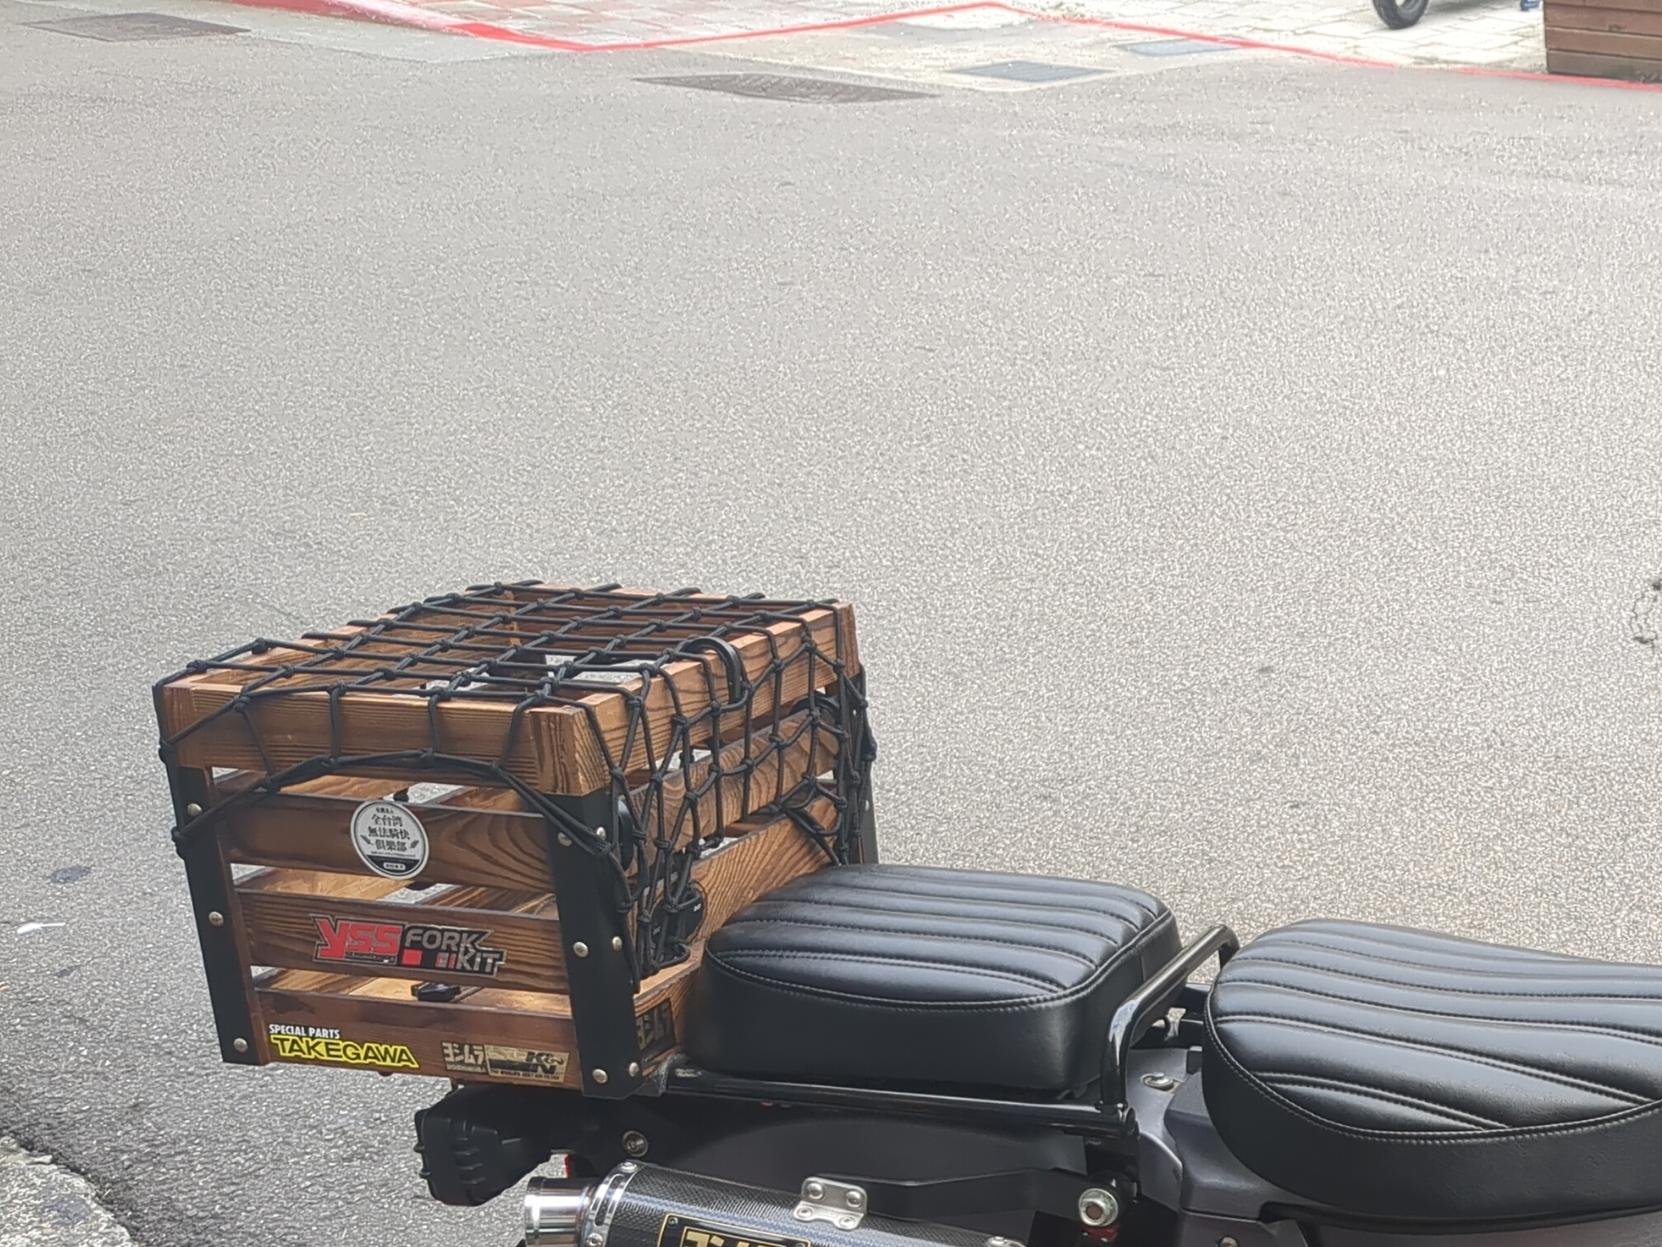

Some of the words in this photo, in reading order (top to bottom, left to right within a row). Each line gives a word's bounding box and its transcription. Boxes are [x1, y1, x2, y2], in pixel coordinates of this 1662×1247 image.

[405, 927, 480, 950] FORK
[456, 943, 501, 973] KIT
[269, 1023, 306, 1037] SPECIAL
[308, 1026, 341, 1040] PARTS
[271, 1036, 418, 1066] TAKEGAWA
